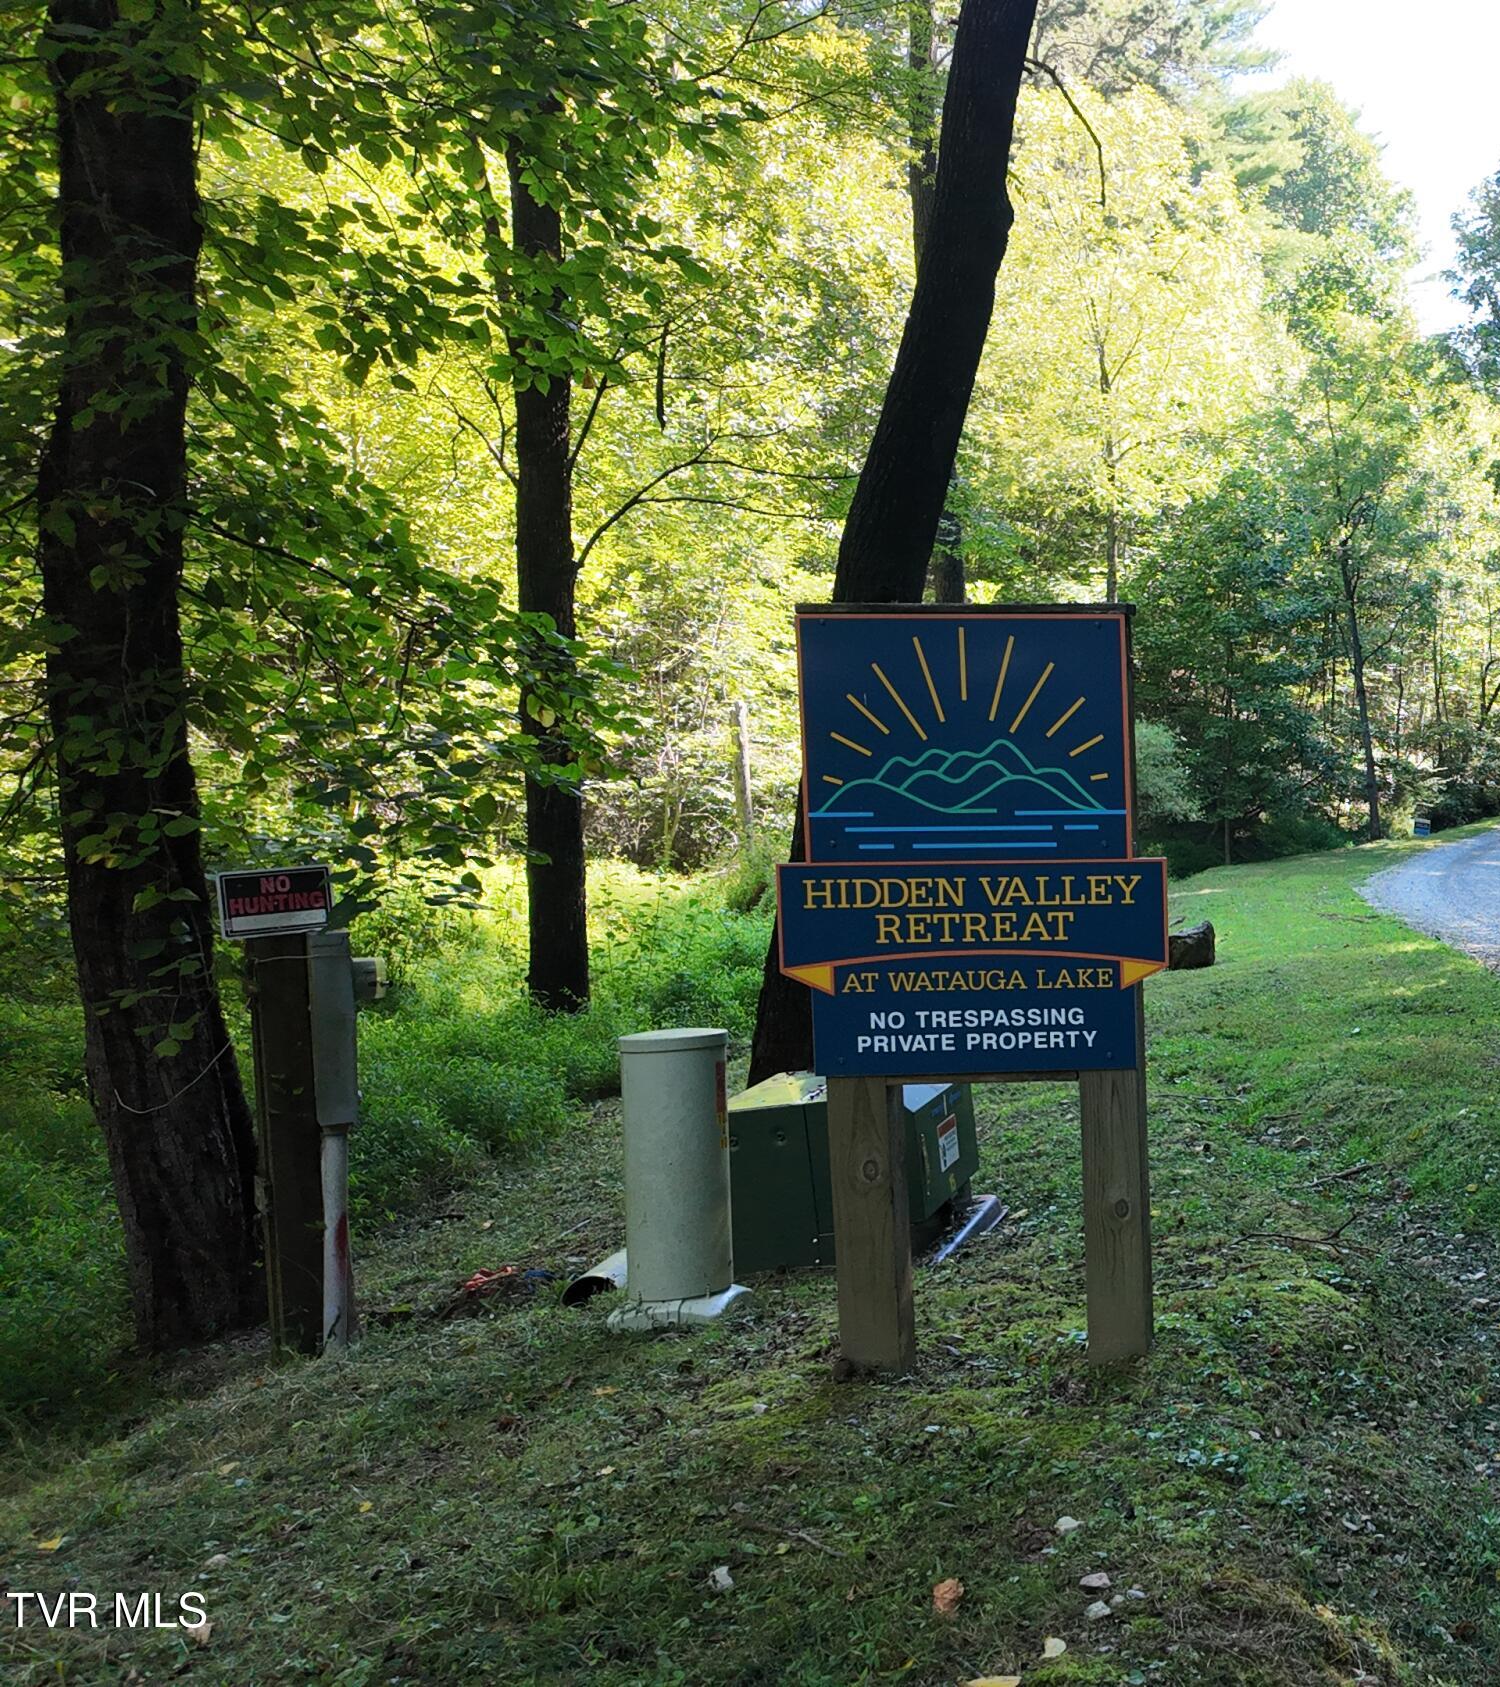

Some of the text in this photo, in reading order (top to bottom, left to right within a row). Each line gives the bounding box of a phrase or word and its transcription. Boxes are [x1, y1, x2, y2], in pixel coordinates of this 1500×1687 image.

[260, 875, 291, 893] NO
[802, 875, 1142, 909] HIDDEN VALLEY
[229, 891, 325, 915] HUNTING
[875, 911, 1074, 944] RETREAT
[842, 968, 1114, 993] AT WATAUGA LAKE
[870, 1007, 1085, 1030] NO TRESPASSING
[857, 1030, 1097, 1053] PRIVATE PROPERTY
